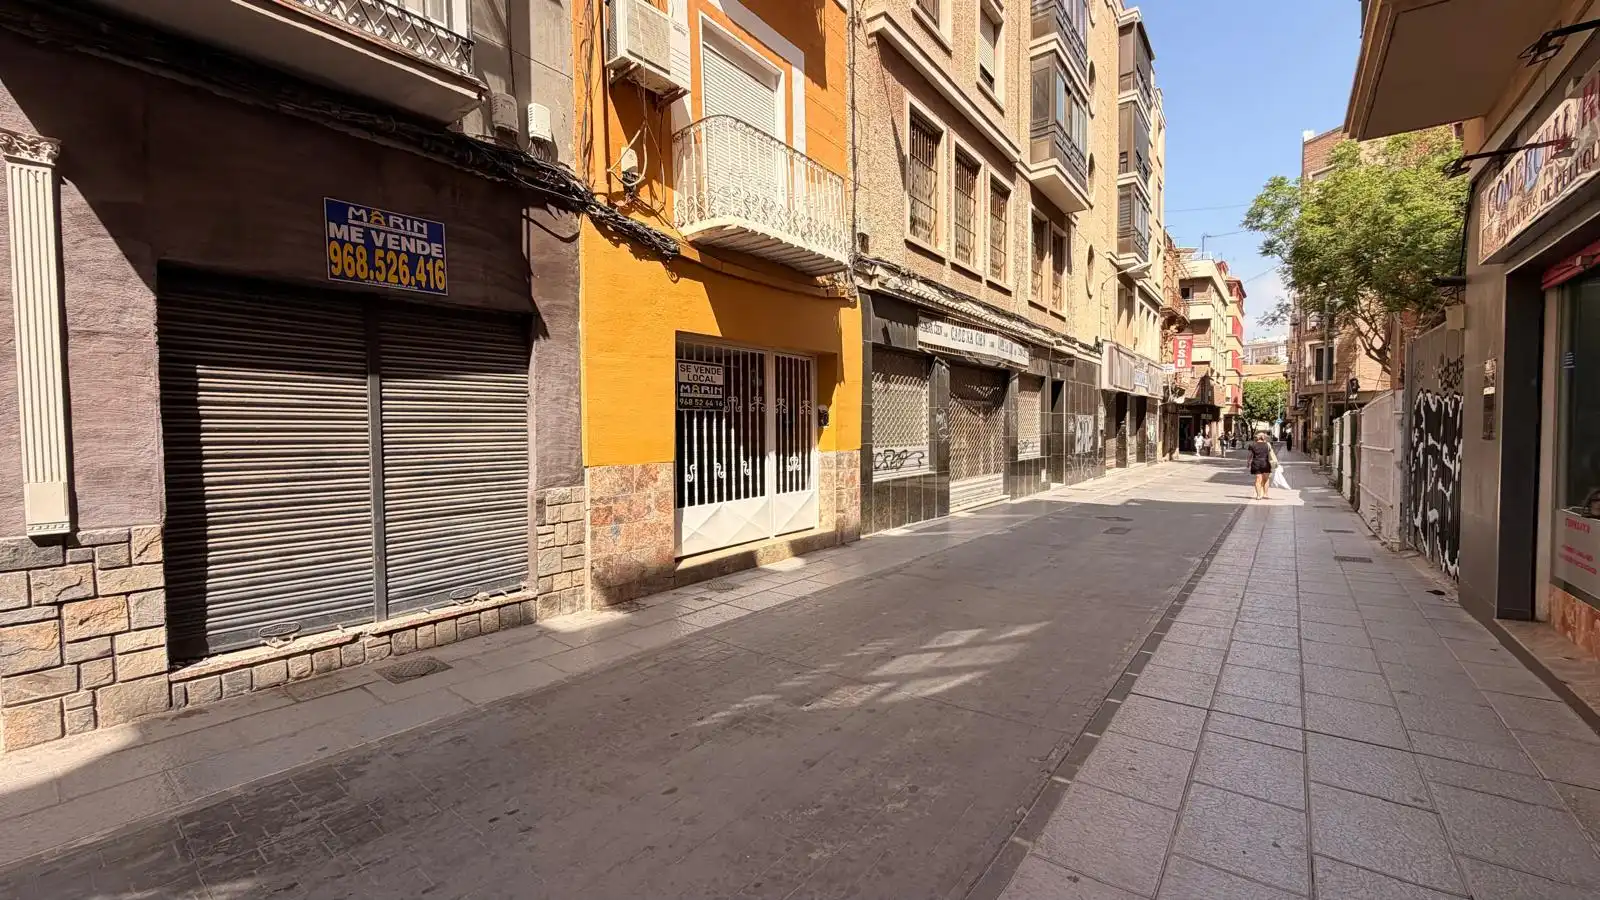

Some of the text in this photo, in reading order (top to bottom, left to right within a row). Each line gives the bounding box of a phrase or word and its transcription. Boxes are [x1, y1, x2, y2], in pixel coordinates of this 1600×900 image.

[1540, 183, 1553, 206] DE
[348, 206, 428, 235] MARIN
[328, 221, 444, 258] ME VENDE
[329, 240, 446, 290] 968.526.416
[680, 364, 722, 376] SE VENDE
[687, 373, 716, 383] LOCAL
[680, 384, 722, 394] MARIN
